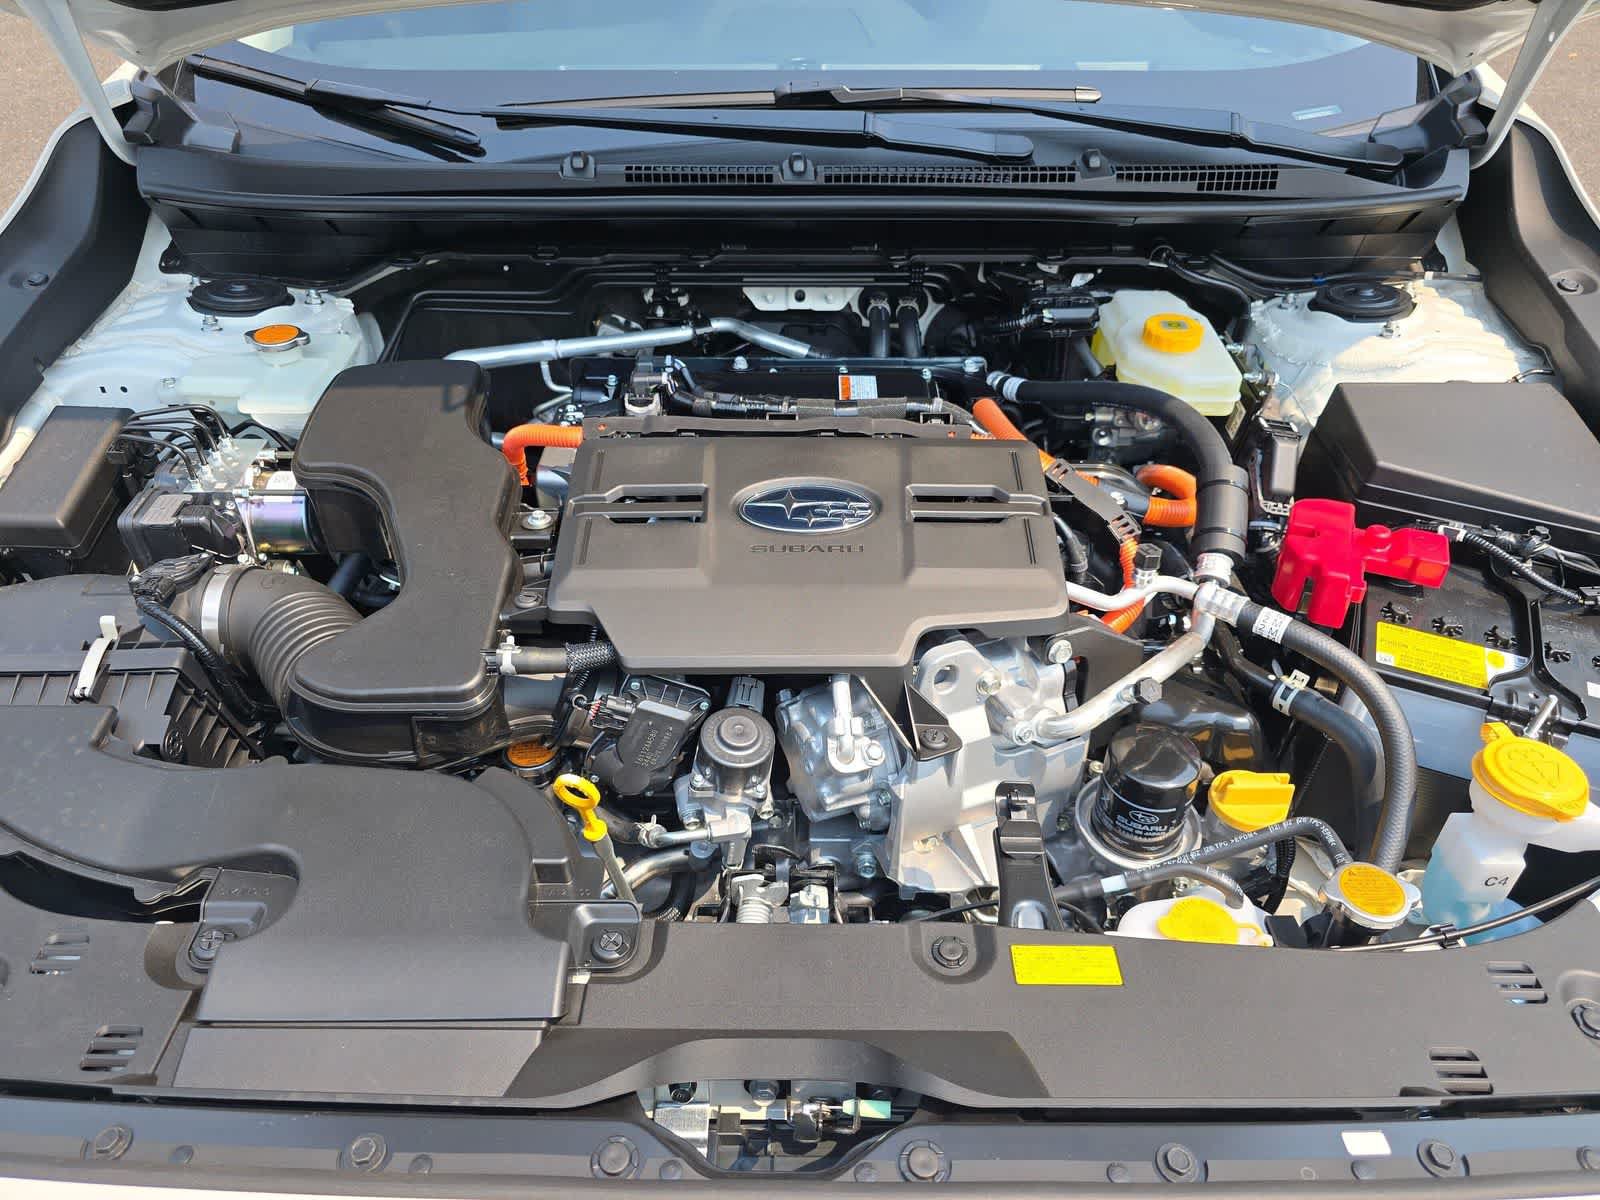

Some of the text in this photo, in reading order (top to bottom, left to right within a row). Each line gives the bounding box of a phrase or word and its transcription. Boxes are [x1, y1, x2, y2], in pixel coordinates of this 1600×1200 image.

[749, 544, 865, 553] SUBARU
[1116, 815, 1168, 831] SUBARU
[1484, 876, 1509, 887] C4
